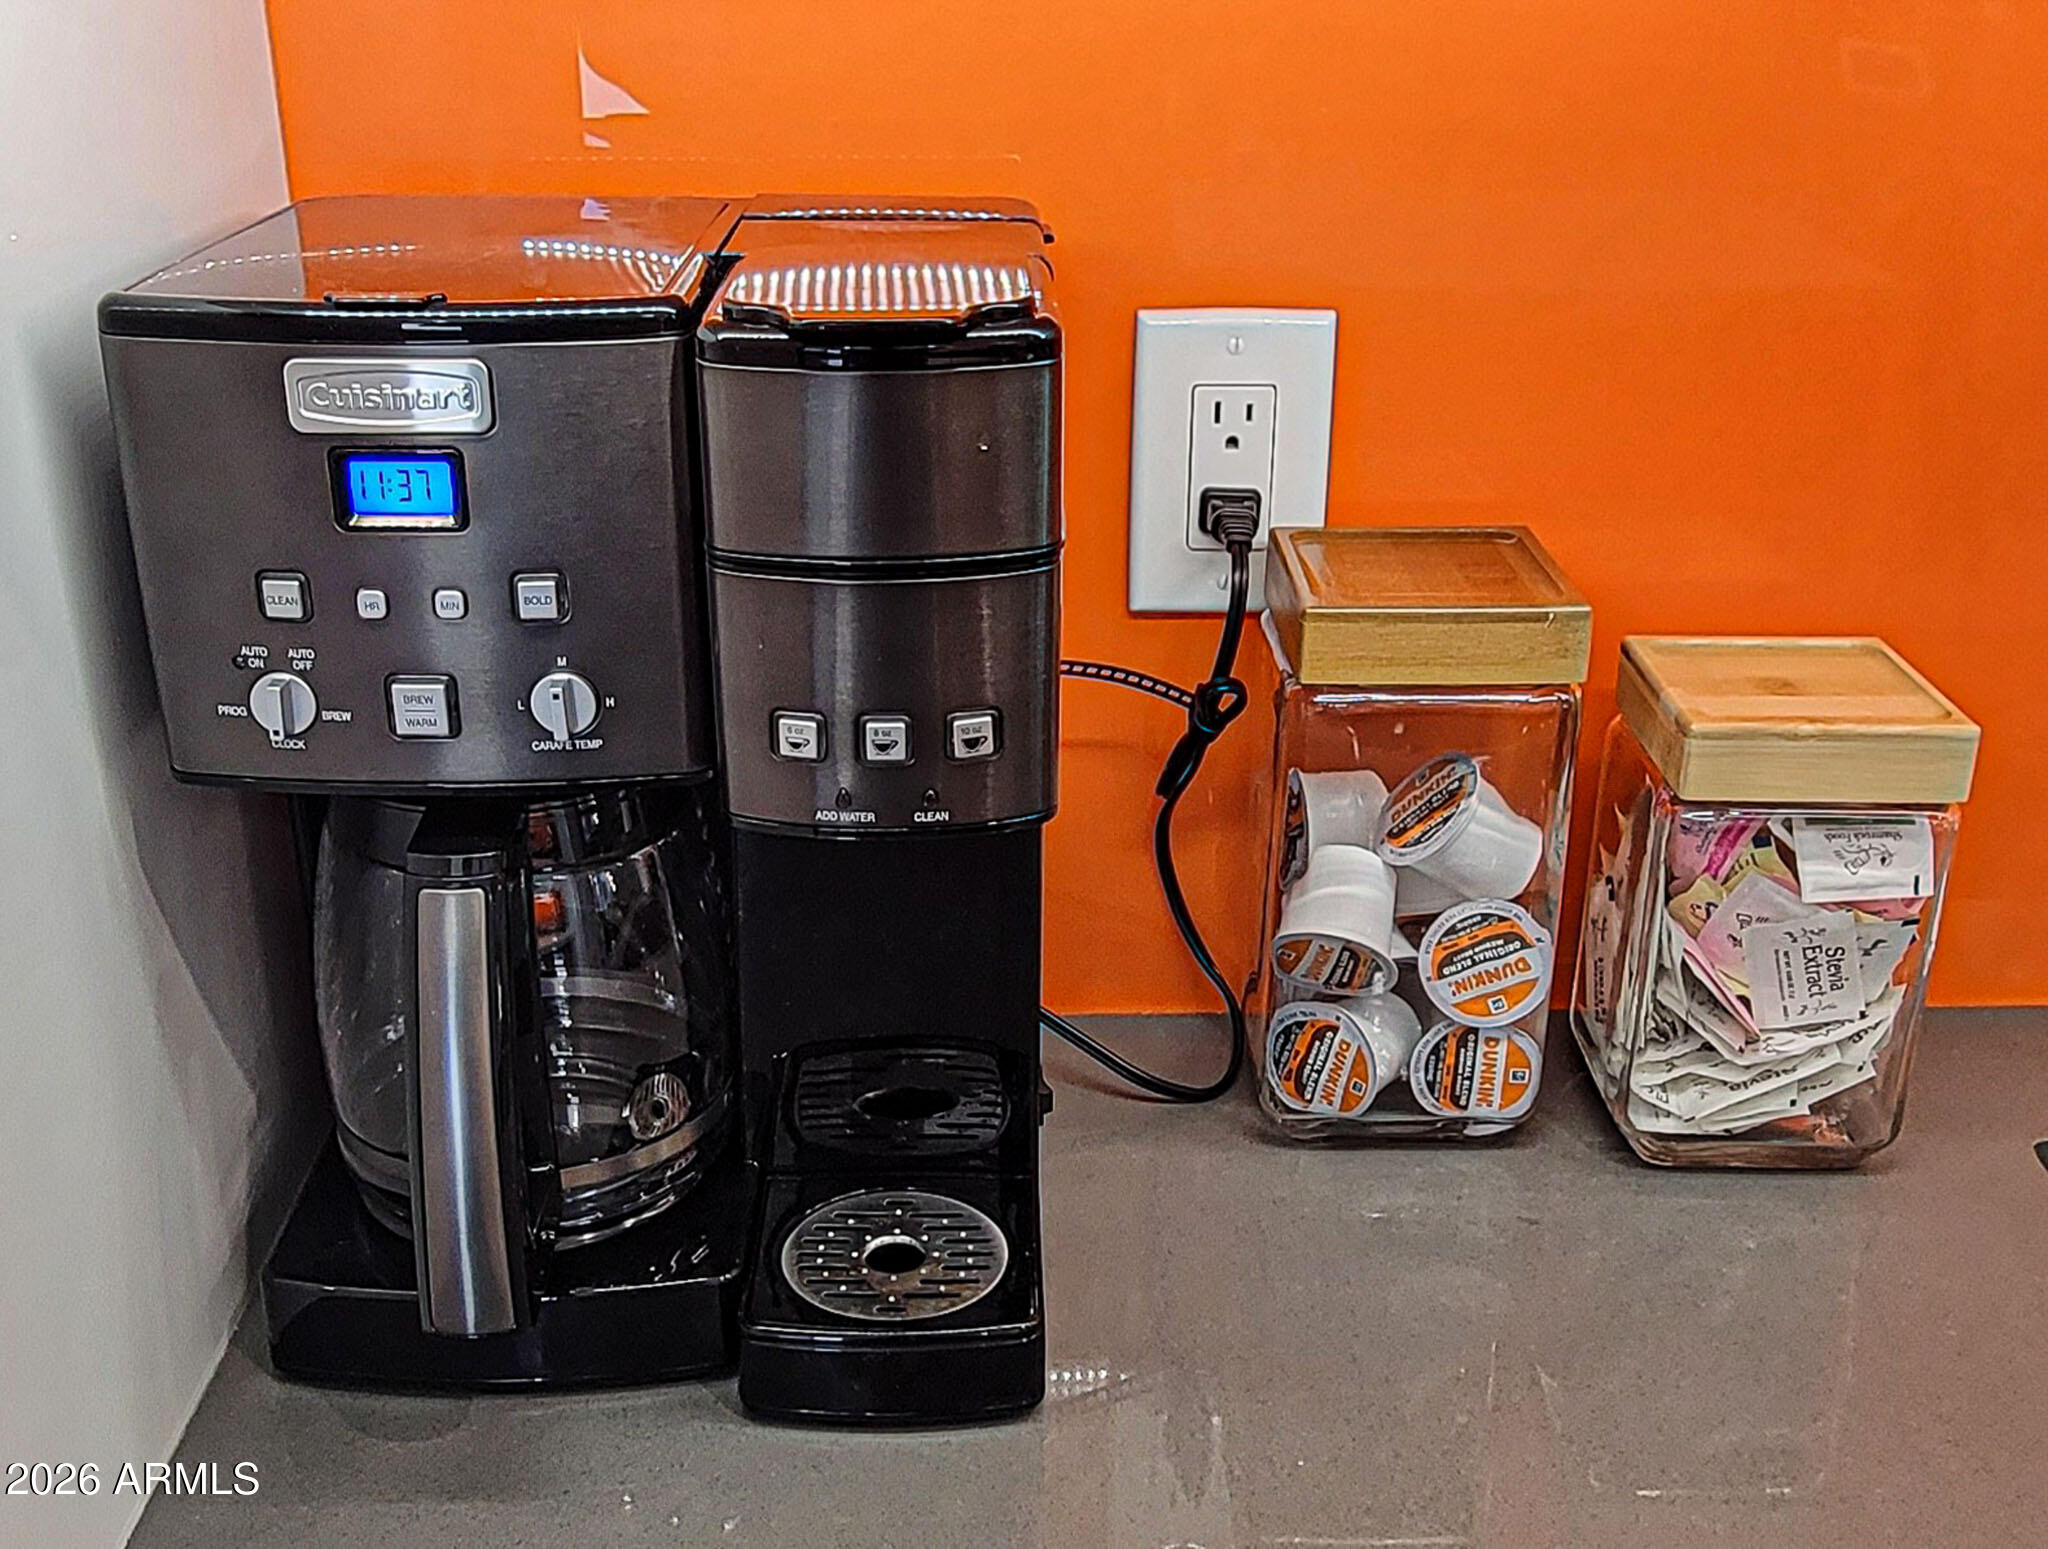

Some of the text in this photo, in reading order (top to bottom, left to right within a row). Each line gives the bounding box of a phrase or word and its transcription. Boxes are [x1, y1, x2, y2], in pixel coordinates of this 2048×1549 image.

[306, 382, 471, 411] Cuisinart
[360, 469, 432, 502] 11:37
[266, 595, 298, 606] CLEAN
[364, 601, 380, 611] HR
[440, 600, 460, 611] MIN
[523, 595, 553, 606] BOLD
[240, 645, 268, 657] AUTO
[287, 648, 315, 660] AUTO
[247, 658, 265, 669] ON
[292, 660, 313, 671] OFF
[556, 656, 568, 667] M
[403, 694, 434, 705] BREW
[605, 697, 616, 708] H
[217, 704, 248, 717] PROG
[517, 700, 526, 711] L
[321, 710, 352, 722] BREW
[405, 718, 438, 728] WARM
[271, 739, 306, 750] CLOCK
[575, 739, 604, 751] TEMP
[815, 811, 876, 824] ADD WATER
[913, 811, 950, 823] CLEAN
[1801, 944, 1828, 999] Extract
[1824, 946, 1850, 992] Stevia
